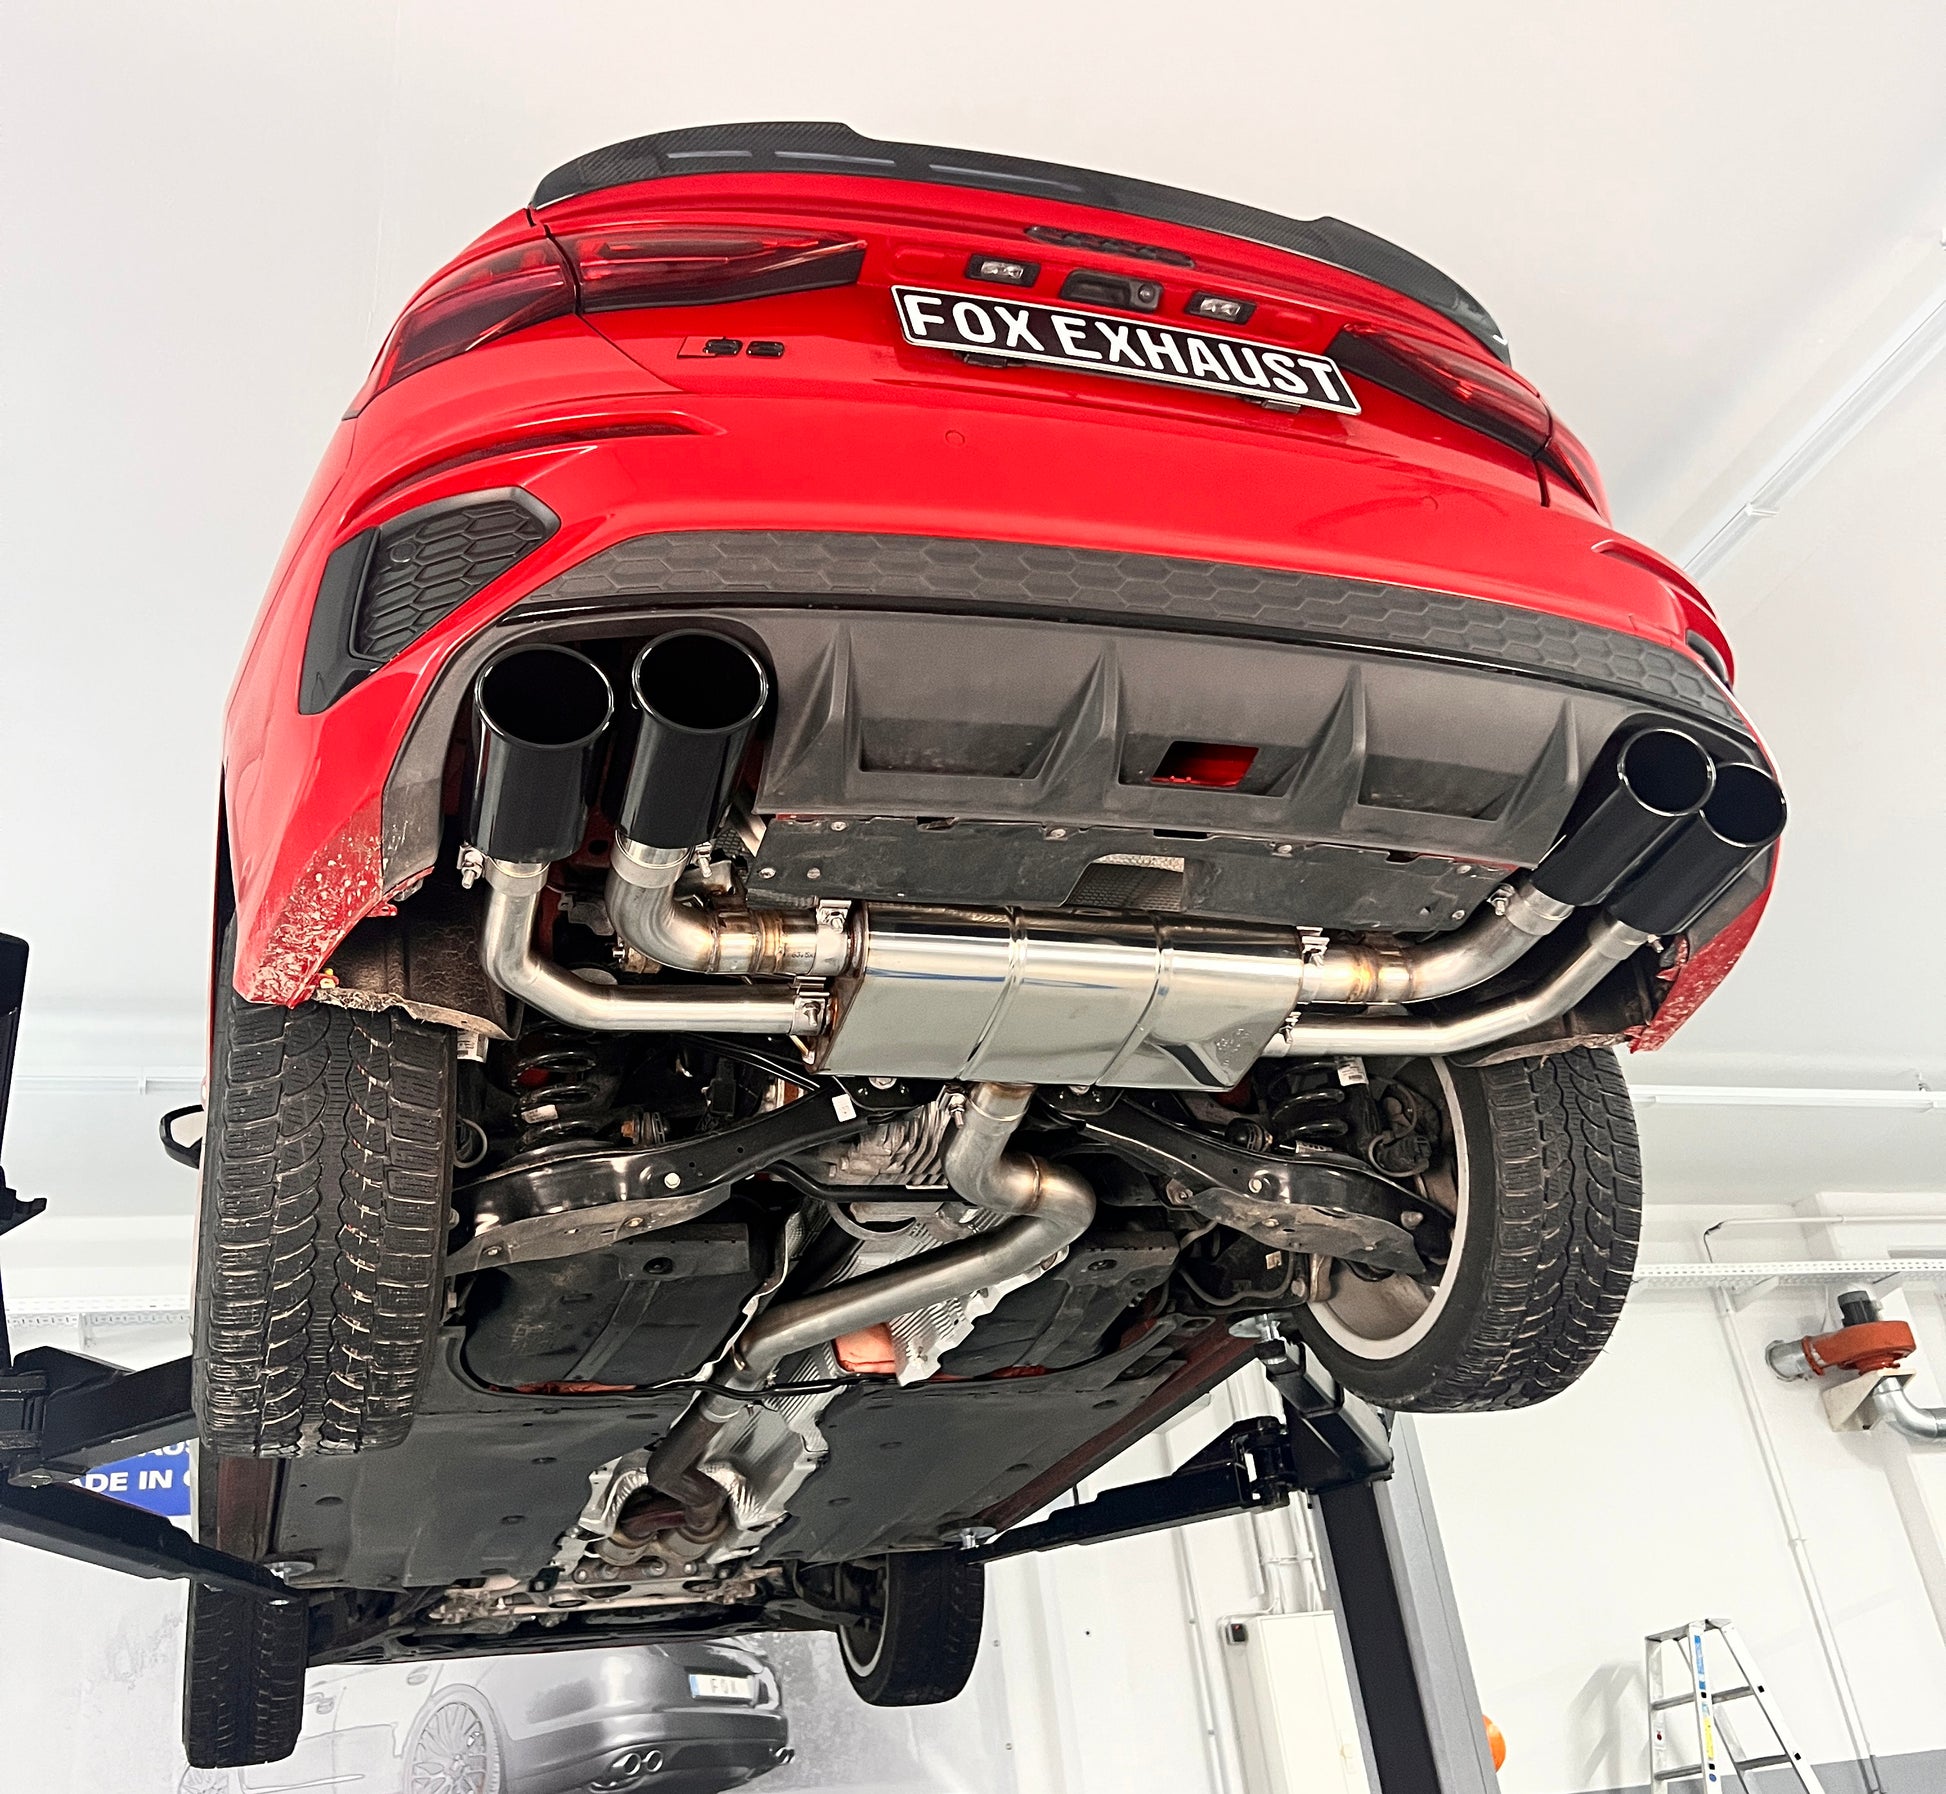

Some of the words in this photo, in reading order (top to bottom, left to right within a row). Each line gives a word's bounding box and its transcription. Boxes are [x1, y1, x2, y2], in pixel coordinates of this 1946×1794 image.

[902, 294, 1045, 352] FOX
[1050, 314, 1341, 402] EXHAUST
[138, 1469, 173, 1490] IN
